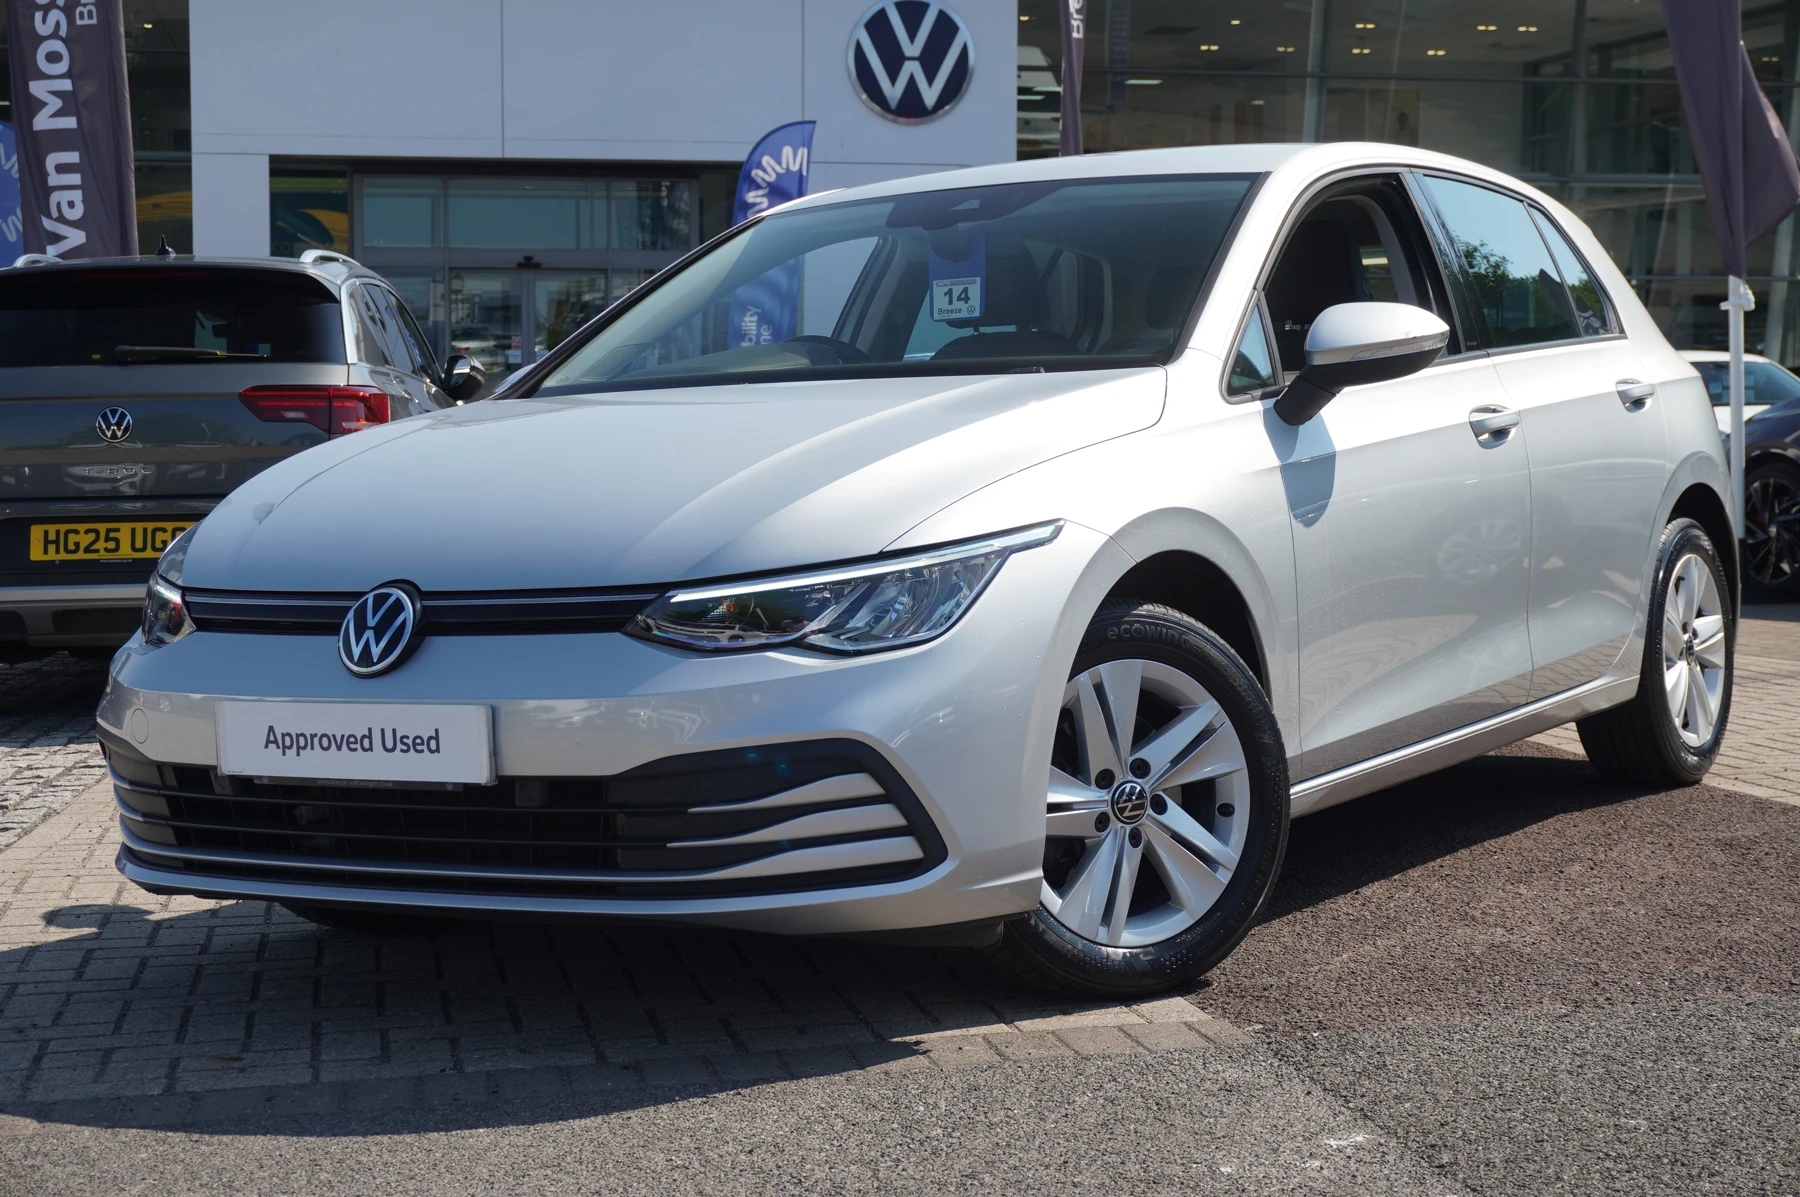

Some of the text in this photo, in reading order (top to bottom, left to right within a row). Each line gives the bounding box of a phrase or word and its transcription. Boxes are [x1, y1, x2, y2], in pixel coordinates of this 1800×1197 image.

[28, 0, 87, 261] Van Mos
[943, 286, 971, 306] 14
[937, 307, 962, 316] Breeze
[82, 466, 153, 476] T-ROC
[42, 528, 121, 556] HG25
[264, 725, 441, 757] Approved Used
